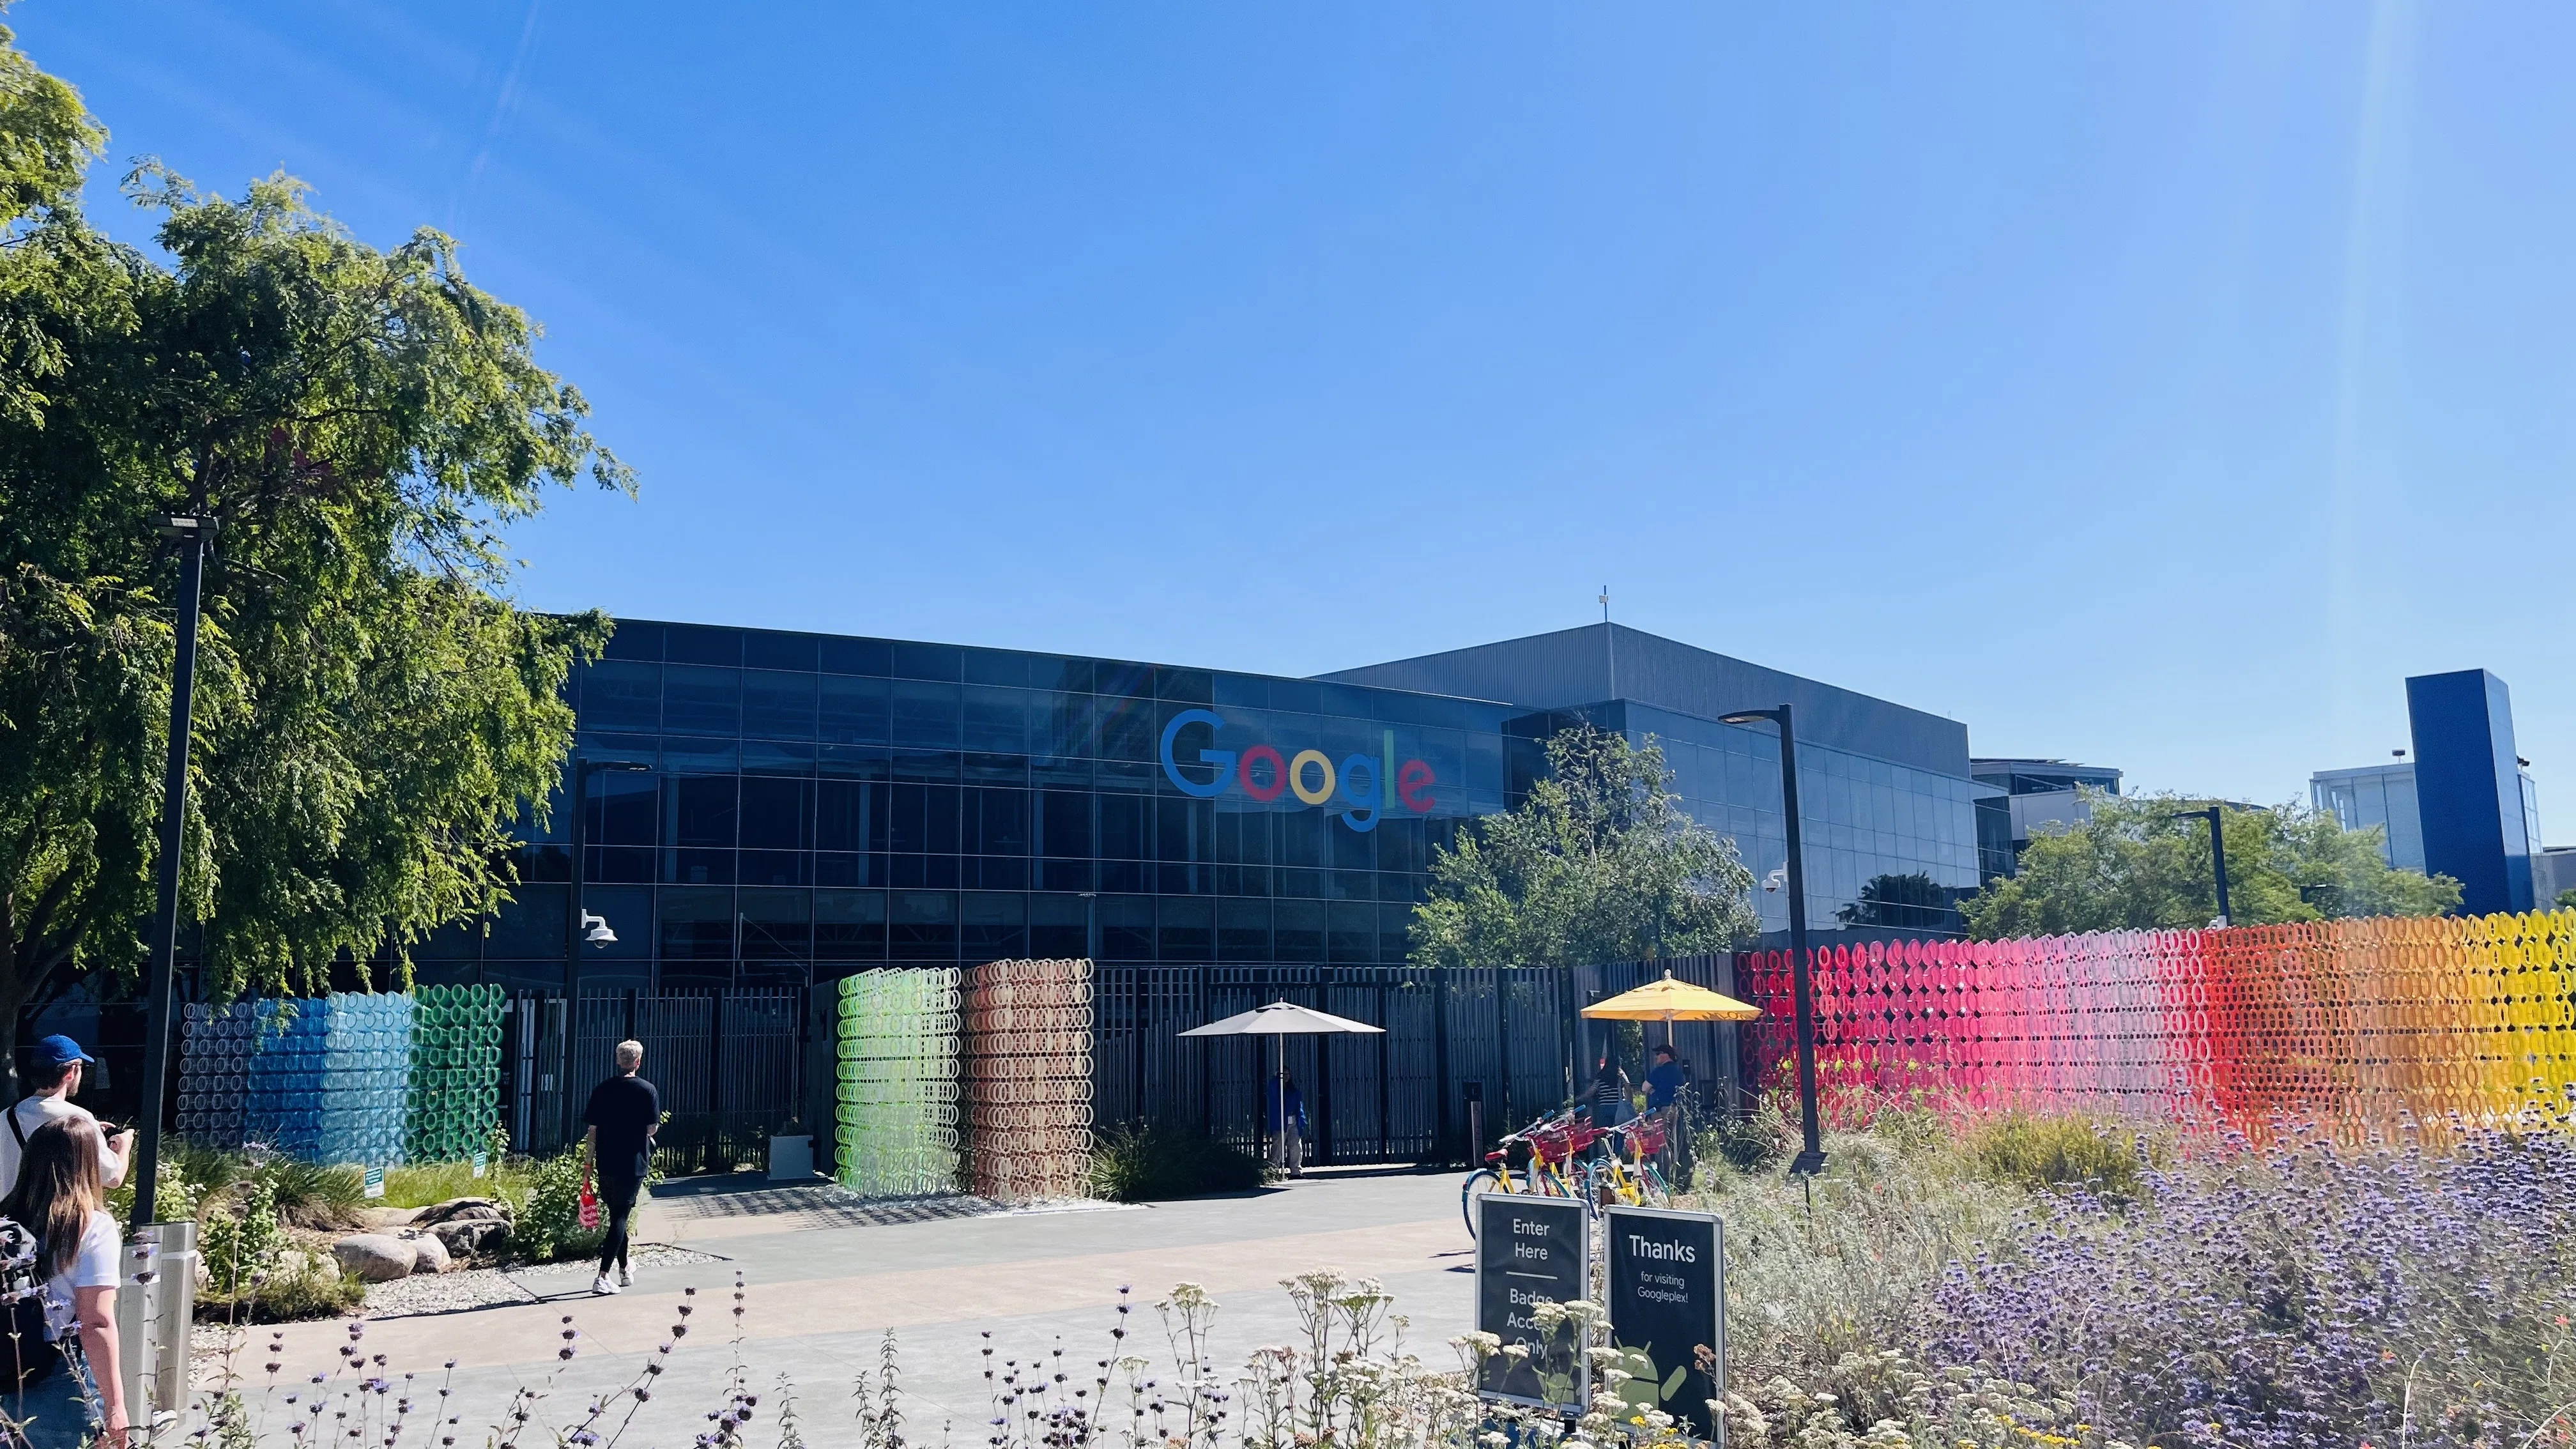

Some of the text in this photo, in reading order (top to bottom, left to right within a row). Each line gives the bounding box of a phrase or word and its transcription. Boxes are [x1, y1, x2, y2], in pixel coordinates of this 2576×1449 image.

[1160, 709, 1436, 832] Google
[1513, 1218, 1551, 1236] Enter
[1515, 1241, 1548, 1261] Here
[1629, 1234, 1696, 1263] Thanks
[1641, 1270, 1685, 1289] for visiting
[1637, 1286, 1689, 1304] Googleplex!
[1506, 1312, 1542, 1331] Acc
